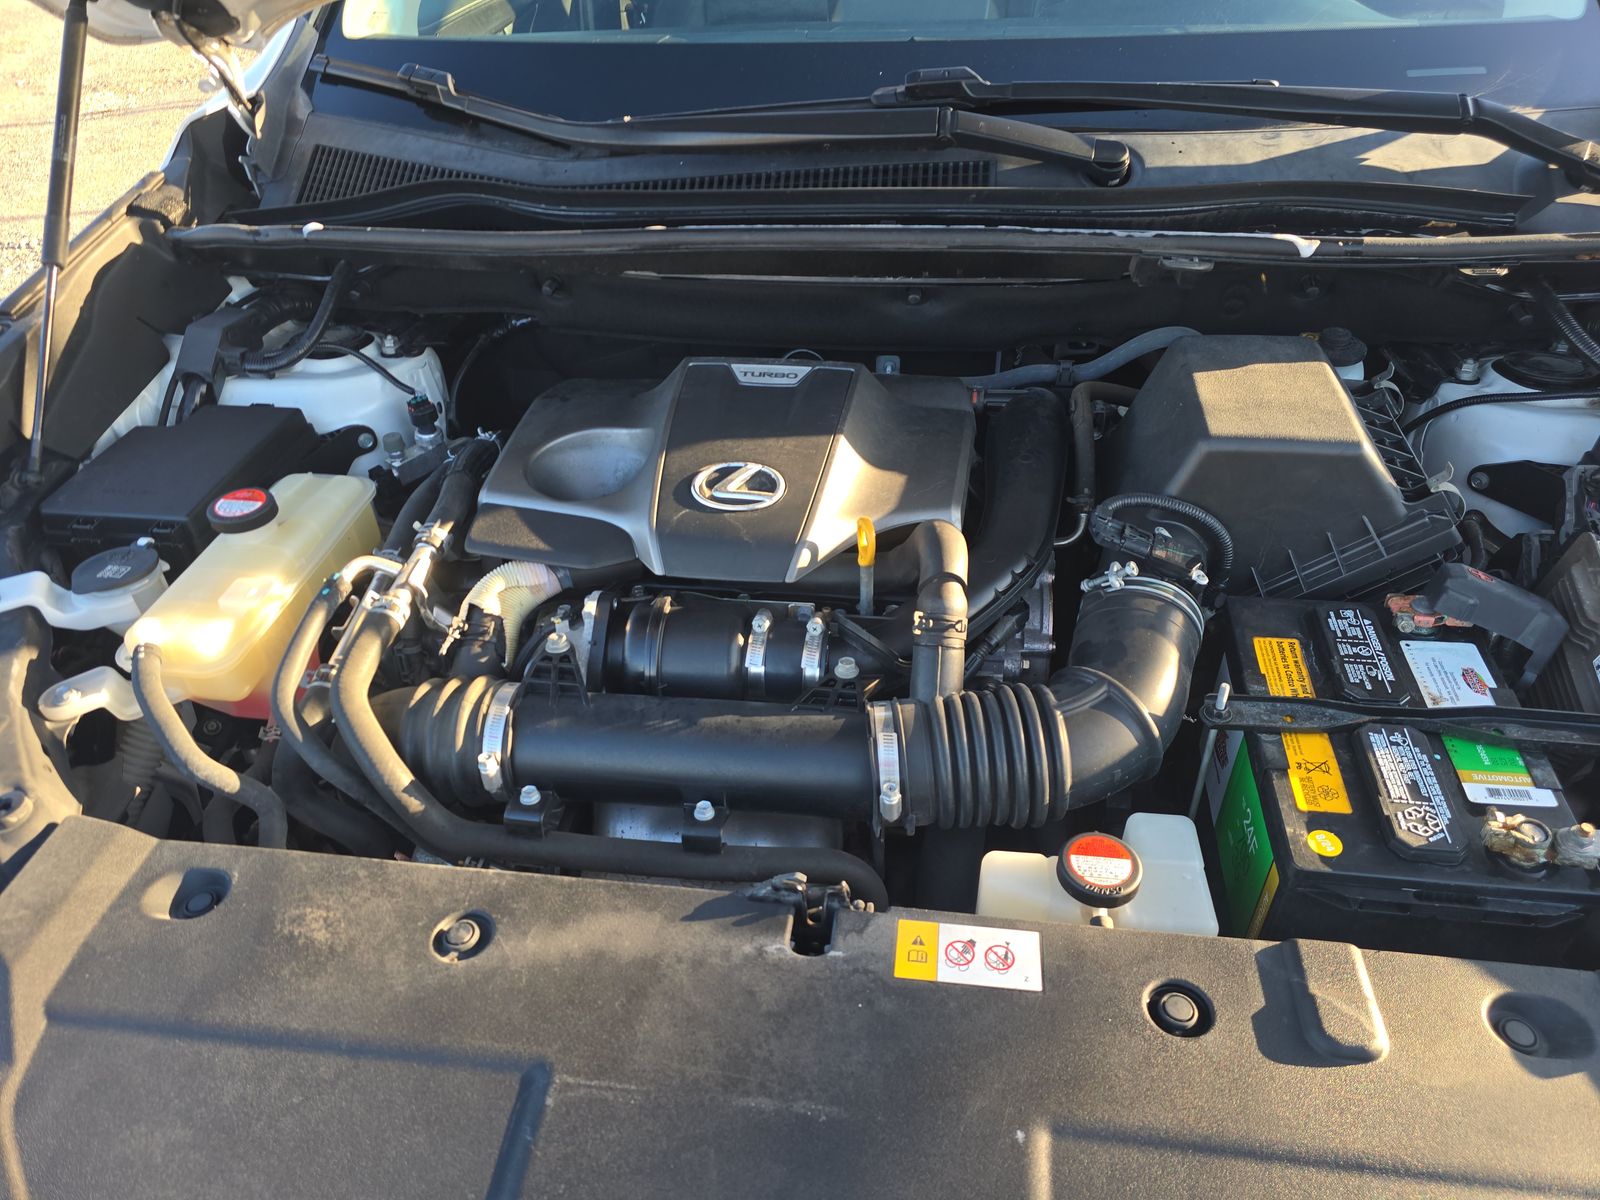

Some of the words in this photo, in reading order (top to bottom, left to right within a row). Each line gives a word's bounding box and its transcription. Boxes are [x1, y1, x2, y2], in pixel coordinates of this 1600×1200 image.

[740, 370, 799, 380] TURBO
[1276, 641, 1289, 662] batteries
[1284, 670, 1295, 686] Costco
[1287, 642, 1297, 658] Return
[1292, 660, 1305, 682] warranty
[1300, 684, 1311, 693] and
[1365, 625, 1381, 650] DANGER
[1377, 657, 1394, 680] POISON
[1085, 884, 1125, 896] DENSO
